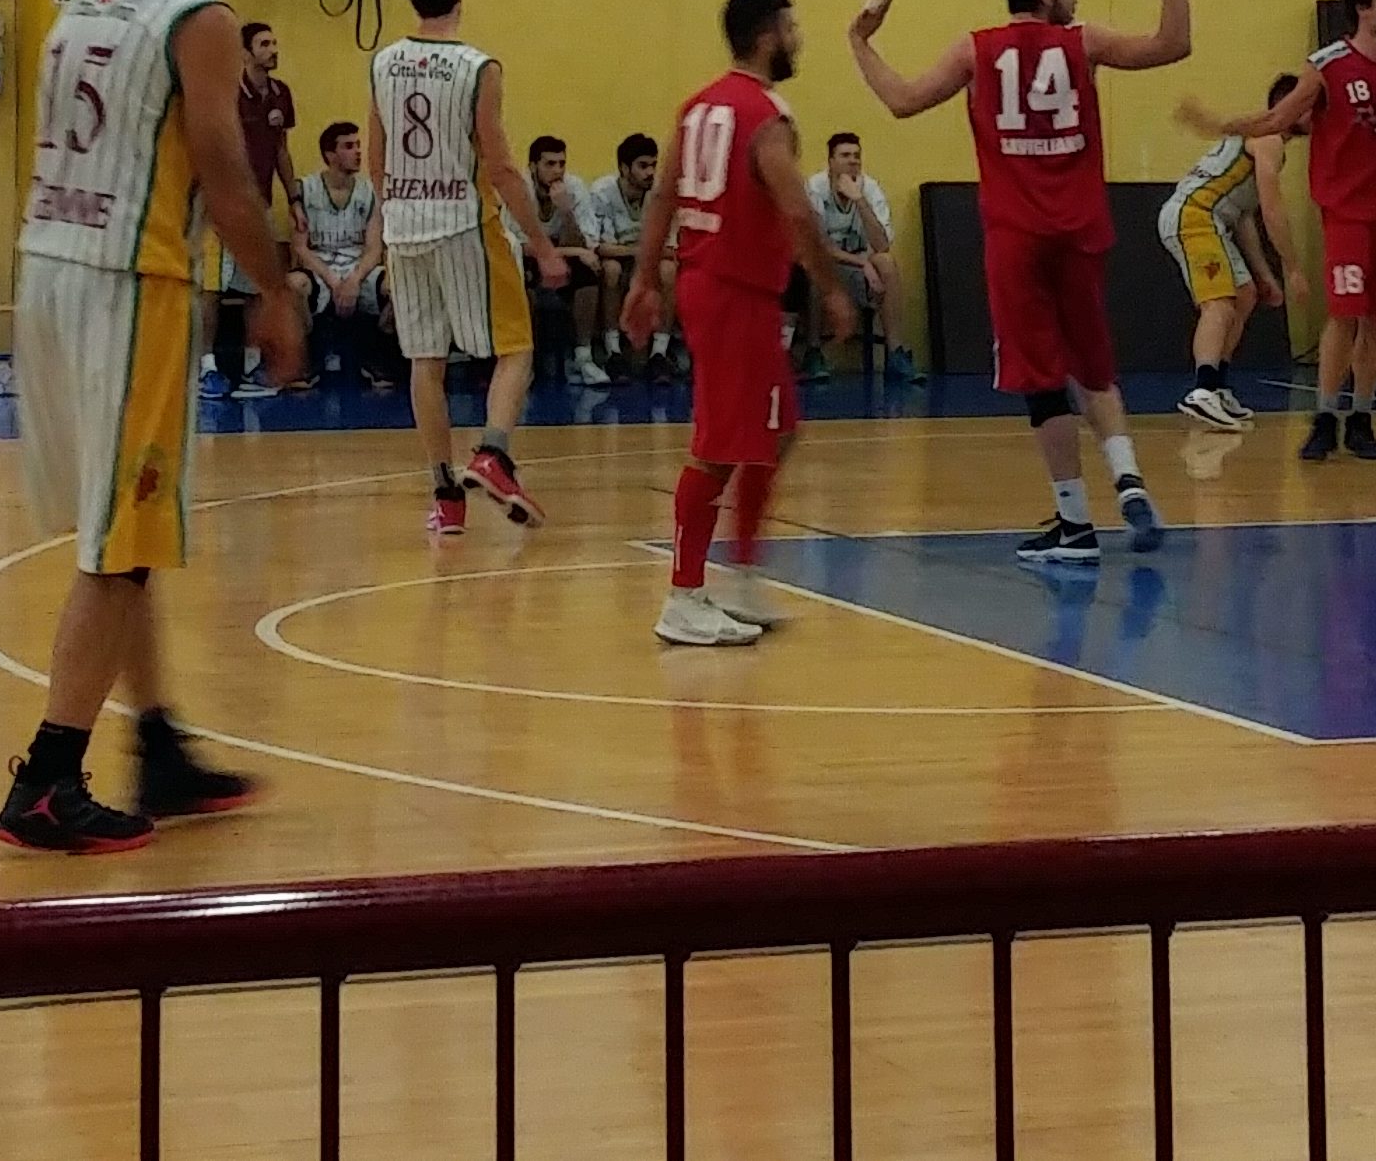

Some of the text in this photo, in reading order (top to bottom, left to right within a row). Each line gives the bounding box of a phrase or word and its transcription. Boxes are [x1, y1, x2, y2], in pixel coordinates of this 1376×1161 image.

[994, 47, 1080, 130] 14
[1346, 80, 1371, 103] 18
[403, 92, 433, 159] 8
[676, 102, 736, 201] 10
[1333, 264, 1364, 295] 18
